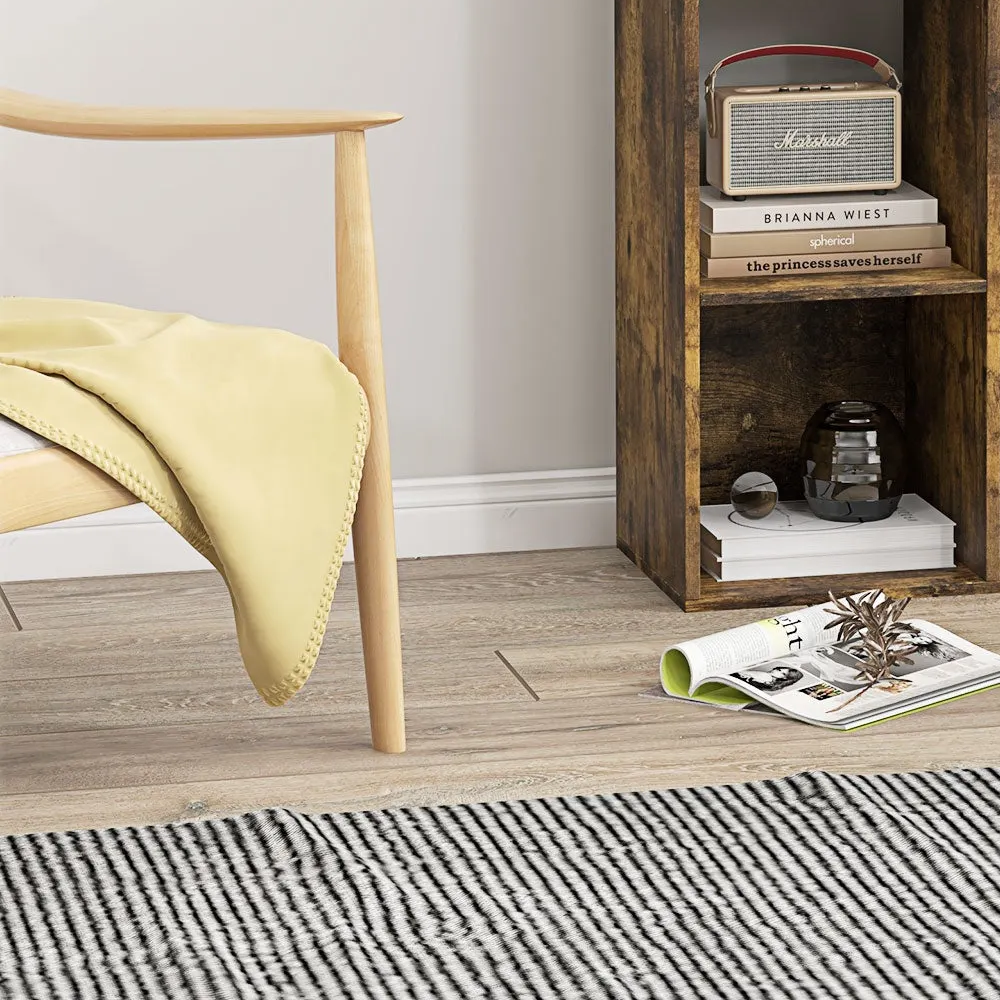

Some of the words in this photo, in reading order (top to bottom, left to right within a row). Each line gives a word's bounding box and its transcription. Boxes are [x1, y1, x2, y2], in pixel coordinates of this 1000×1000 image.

[774, 128, 853, 149] Marshall
[764, 210, 836, 224] BRIANNA
[844, 208, 890, 220] WIEST
[809, 232, 855, 249] spherical
[747, 260, 770, 272] the
[772, 256, 831, 273] princess
[834, 256, 872, 268] saves
[873, 253, 923, 267] herself
